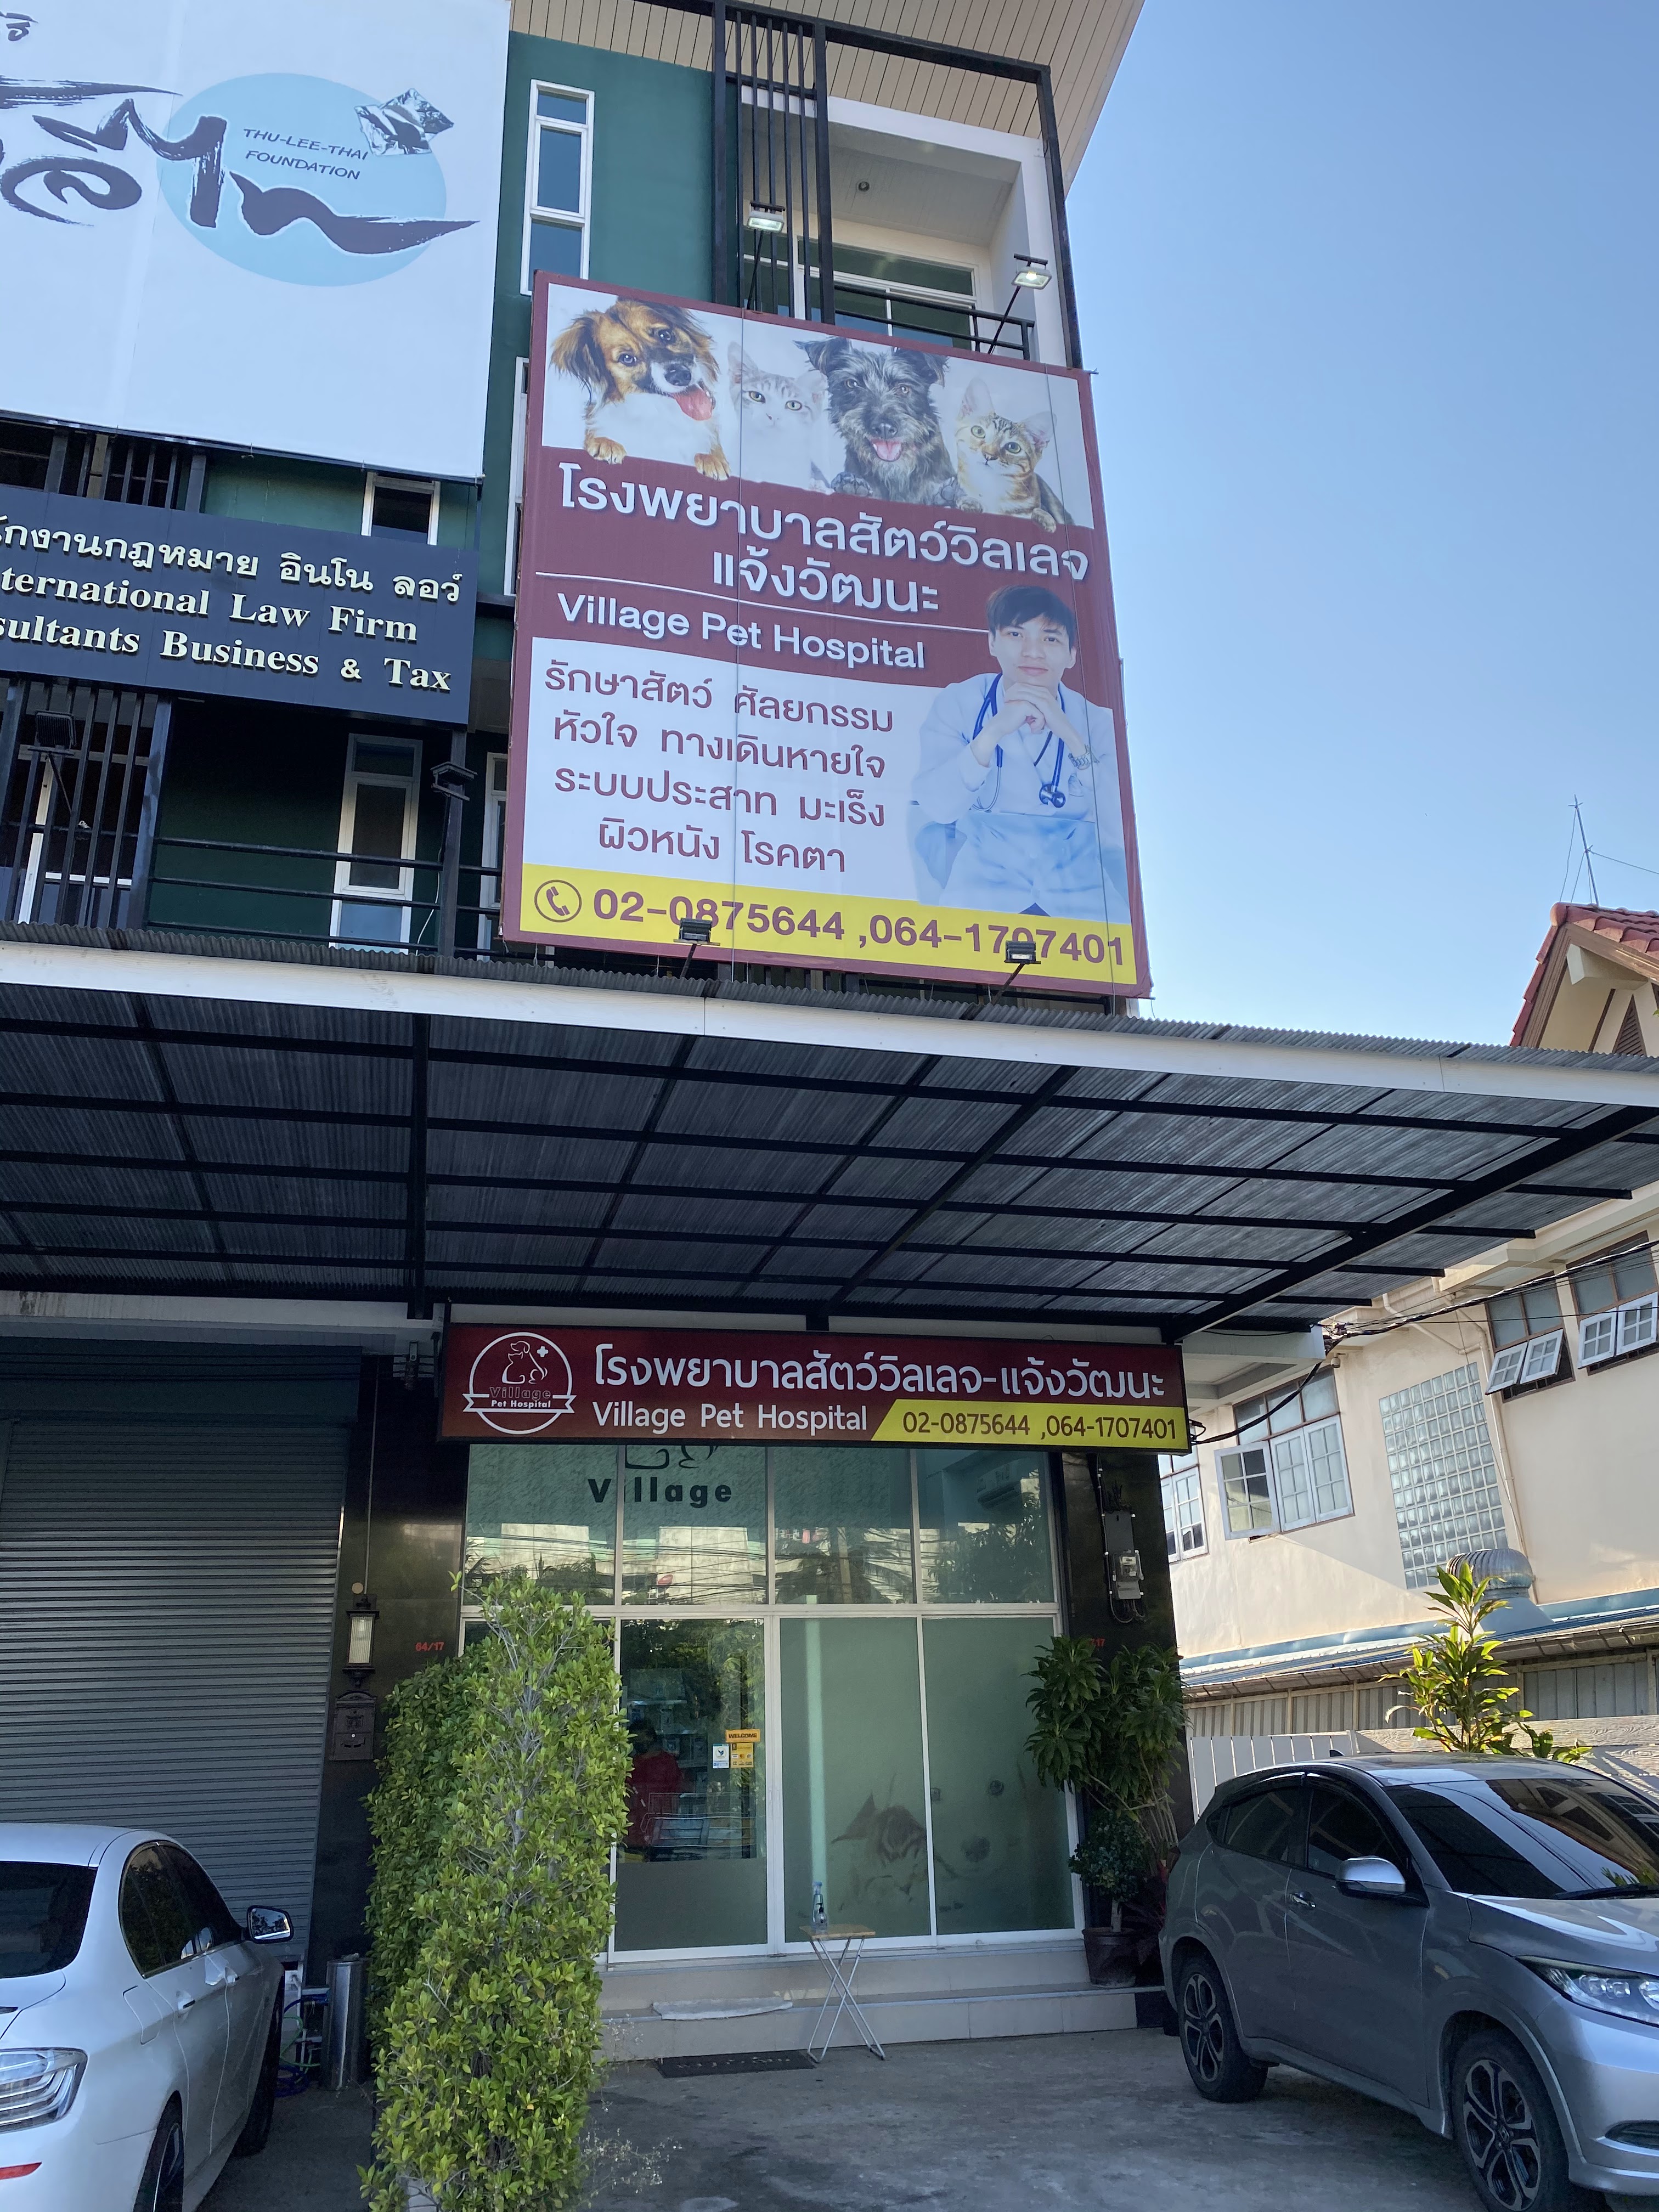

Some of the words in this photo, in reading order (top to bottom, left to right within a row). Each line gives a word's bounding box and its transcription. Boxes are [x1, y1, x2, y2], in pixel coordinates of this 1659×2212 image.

[243, 128, 369, 160] THU-LEE-THAI
[245, 150, 360, 180] FOUNDATION
[558, 462, 1089, 580] โรงพยาบาลสัตว์วิลเลจ
[0, 514, 259, 577] กงานกฎหมาย
[279, 551, 374, 592] อินโน
[392, 573, 463, 602] ลอว์
[714, 545, 939, 612] แจ้งวัฒนะ
[229, 593, 311, 628] Law
[328, 605, 417, 641] Firm
[557, 592, 690, 639] Village
[702, 611, 762, 650] Pet
[774, 624, 925, 669] Hospital
[159, 629, 319, 675] Business
[340, 658, 362, 680] &
[384, 658, 452, 691] Tax
[545, 659, 713, 708] รักษาสัตว์
[735, 685, 893, 732] ศัลยกรรม
[554, 709, 637, 748] หัวใจ
[662, 729, 885, 778] ทางเดินหายใจ
[555, 768, 777, 816] ระบบประสาท
[799, 788, 885, 827] มะเร็ง
[599, 817, 719, 860] ผิวหนัง
[741, 830, 845, 872] โรคตา
[593, 888, 845, 940] 02-0875644
[489, 1386, 551, 1401] Village
[595, 1343, 1165, 1400] โรงพยาบาลสัตว์วิลเลจ-แจ้งวัฒนะ
[510, 1400, 551, 1409] Hospital
[592, 1401, 686, 1435] Village
[700, 1403, 744, 1429] Pet
[758, 1404, 867, 1436] Hospital
[902, 1411, 1030, 1436] 02-0875644
[588, 1476, 732, 1509] Vllage
